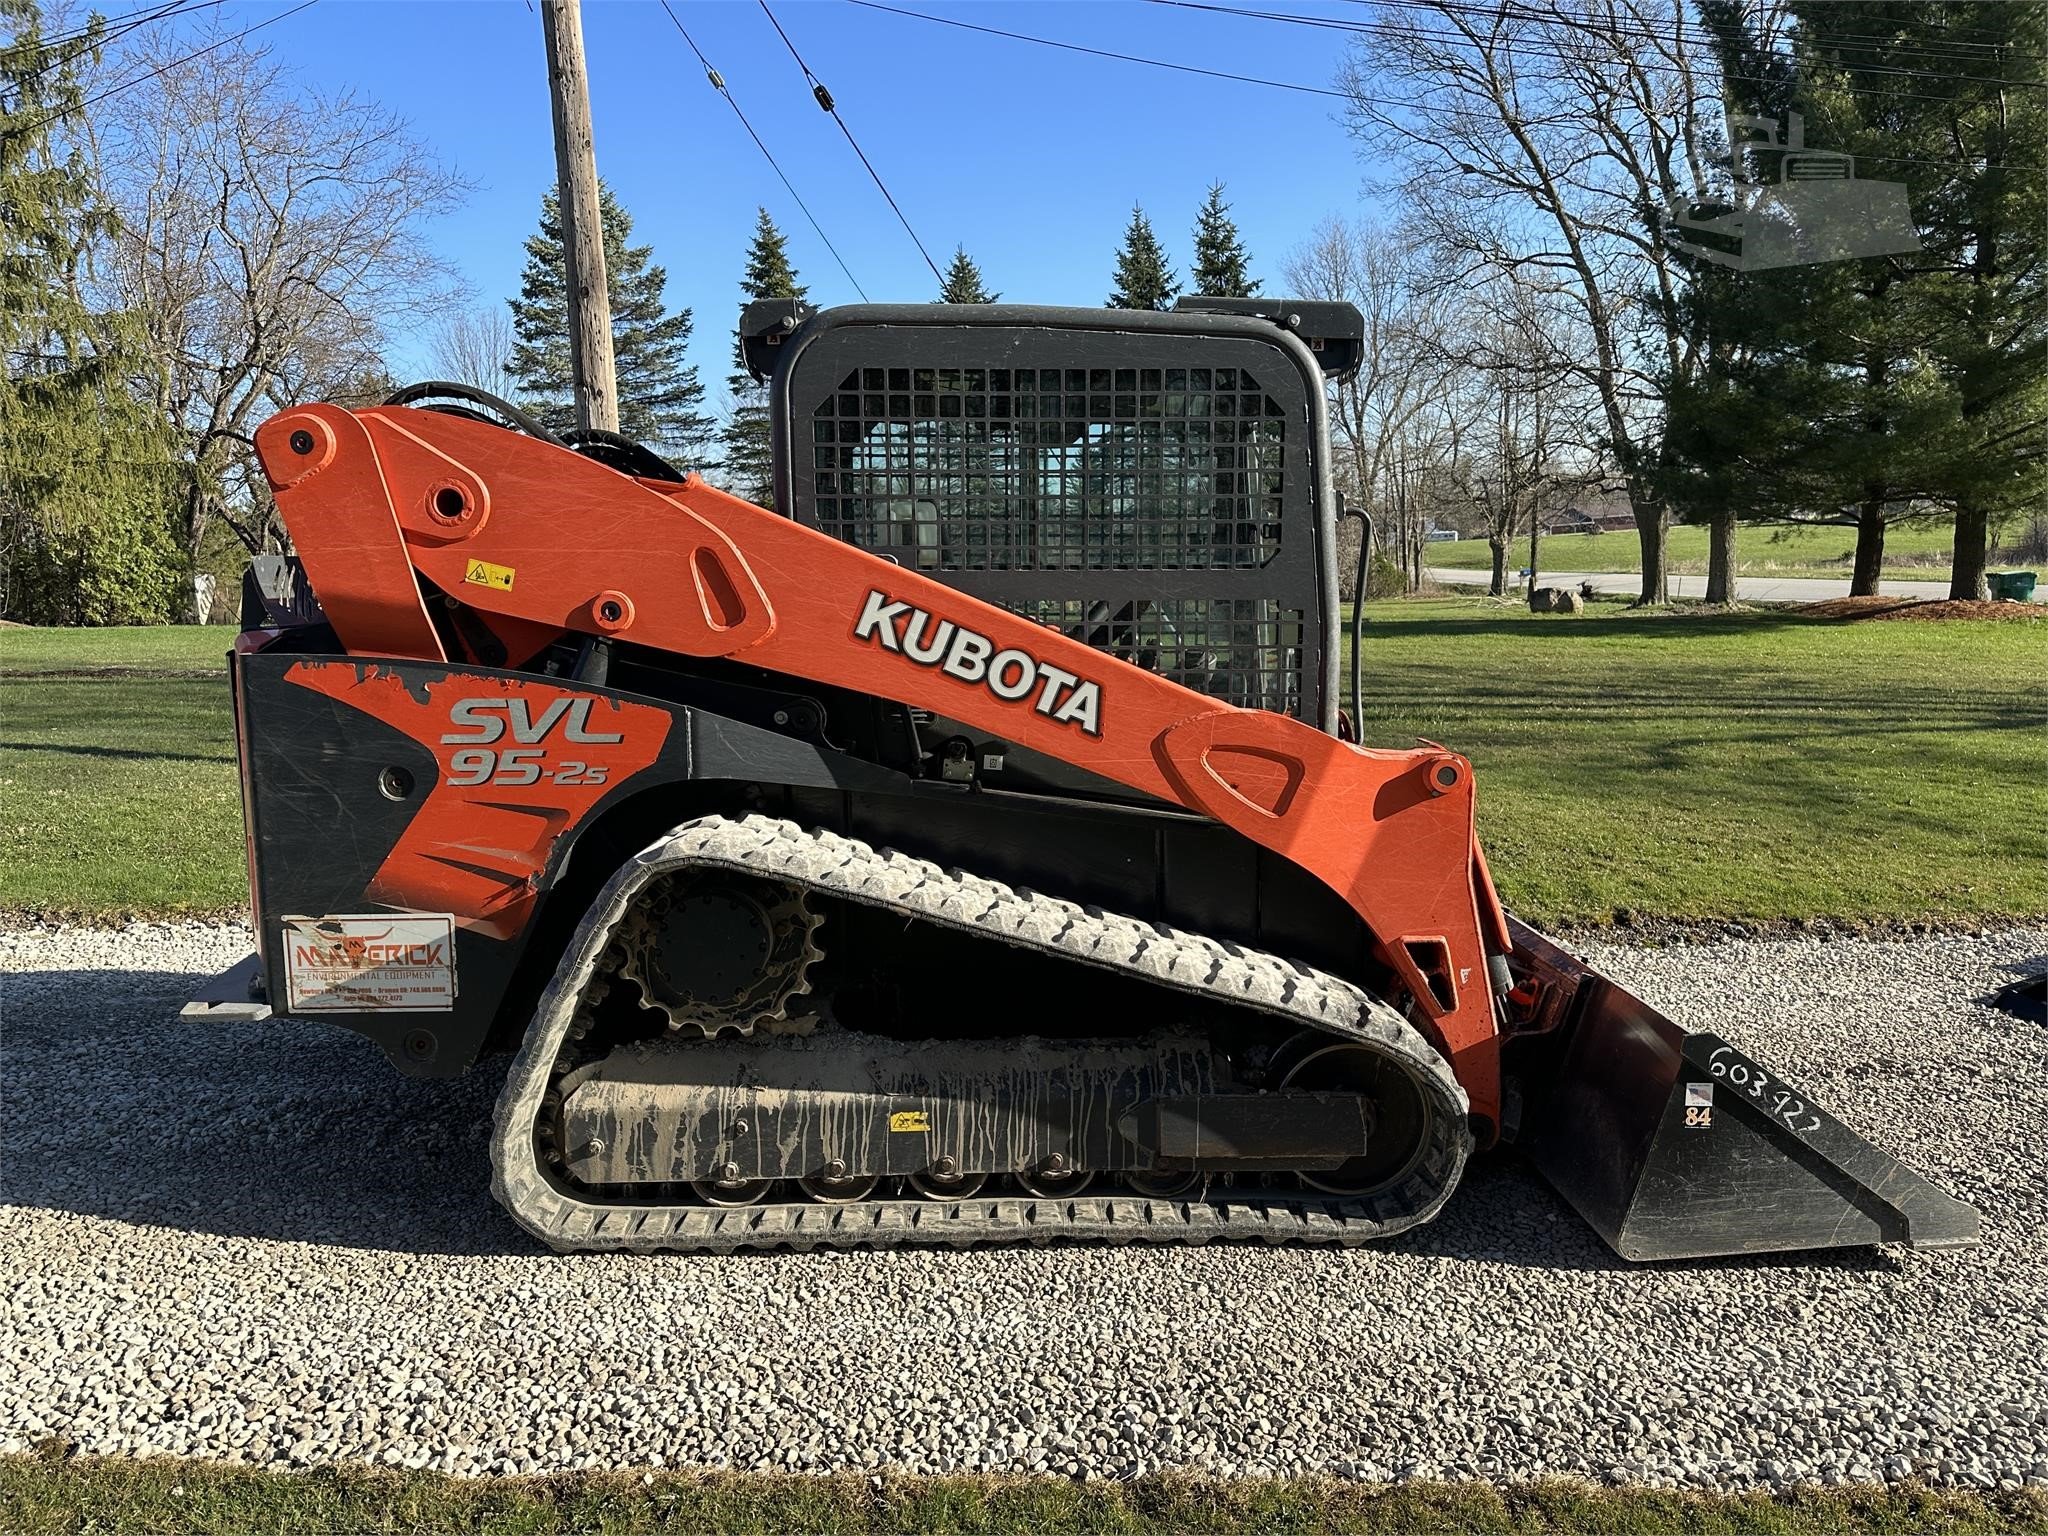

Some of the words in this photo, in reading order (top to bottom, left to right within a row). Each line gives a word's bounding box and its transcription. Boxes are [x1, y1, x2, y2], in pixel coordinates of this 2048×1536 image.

[854, 590, 1103, 736] KUBOTA
[440, 698, 624, 745] SVL
[296, 944, 444, 968] MAVERICK
[307, 971, 382, 981] ENVIRONMENTAL
[384, 971, 436, 980] EQUIPMENT
[1685, 1107, 1712, 1126] 84
